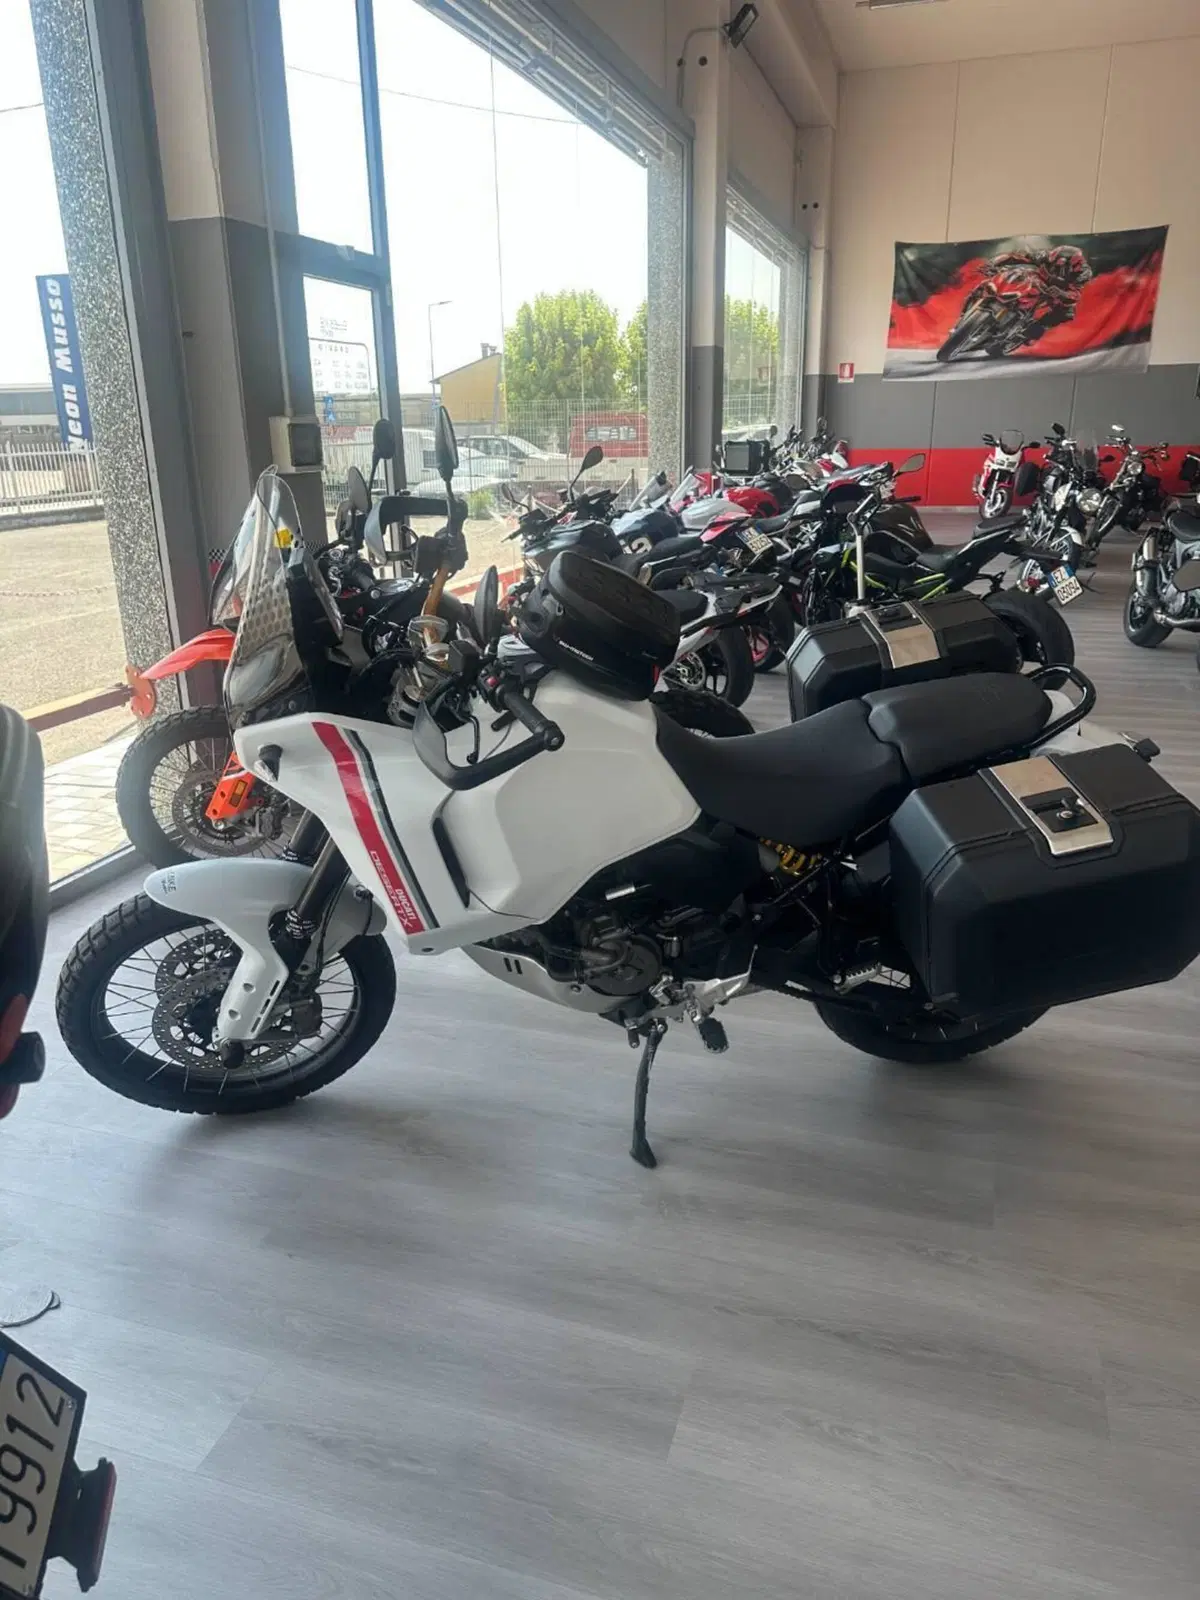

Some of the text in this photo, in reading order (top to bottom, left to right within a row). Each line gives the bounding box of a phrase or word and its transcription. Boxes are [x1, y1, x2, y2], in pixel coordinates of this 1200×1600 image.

[46, 278, 87, 451] Neon Musso
[395, 888, 417, 920] DUCATI
